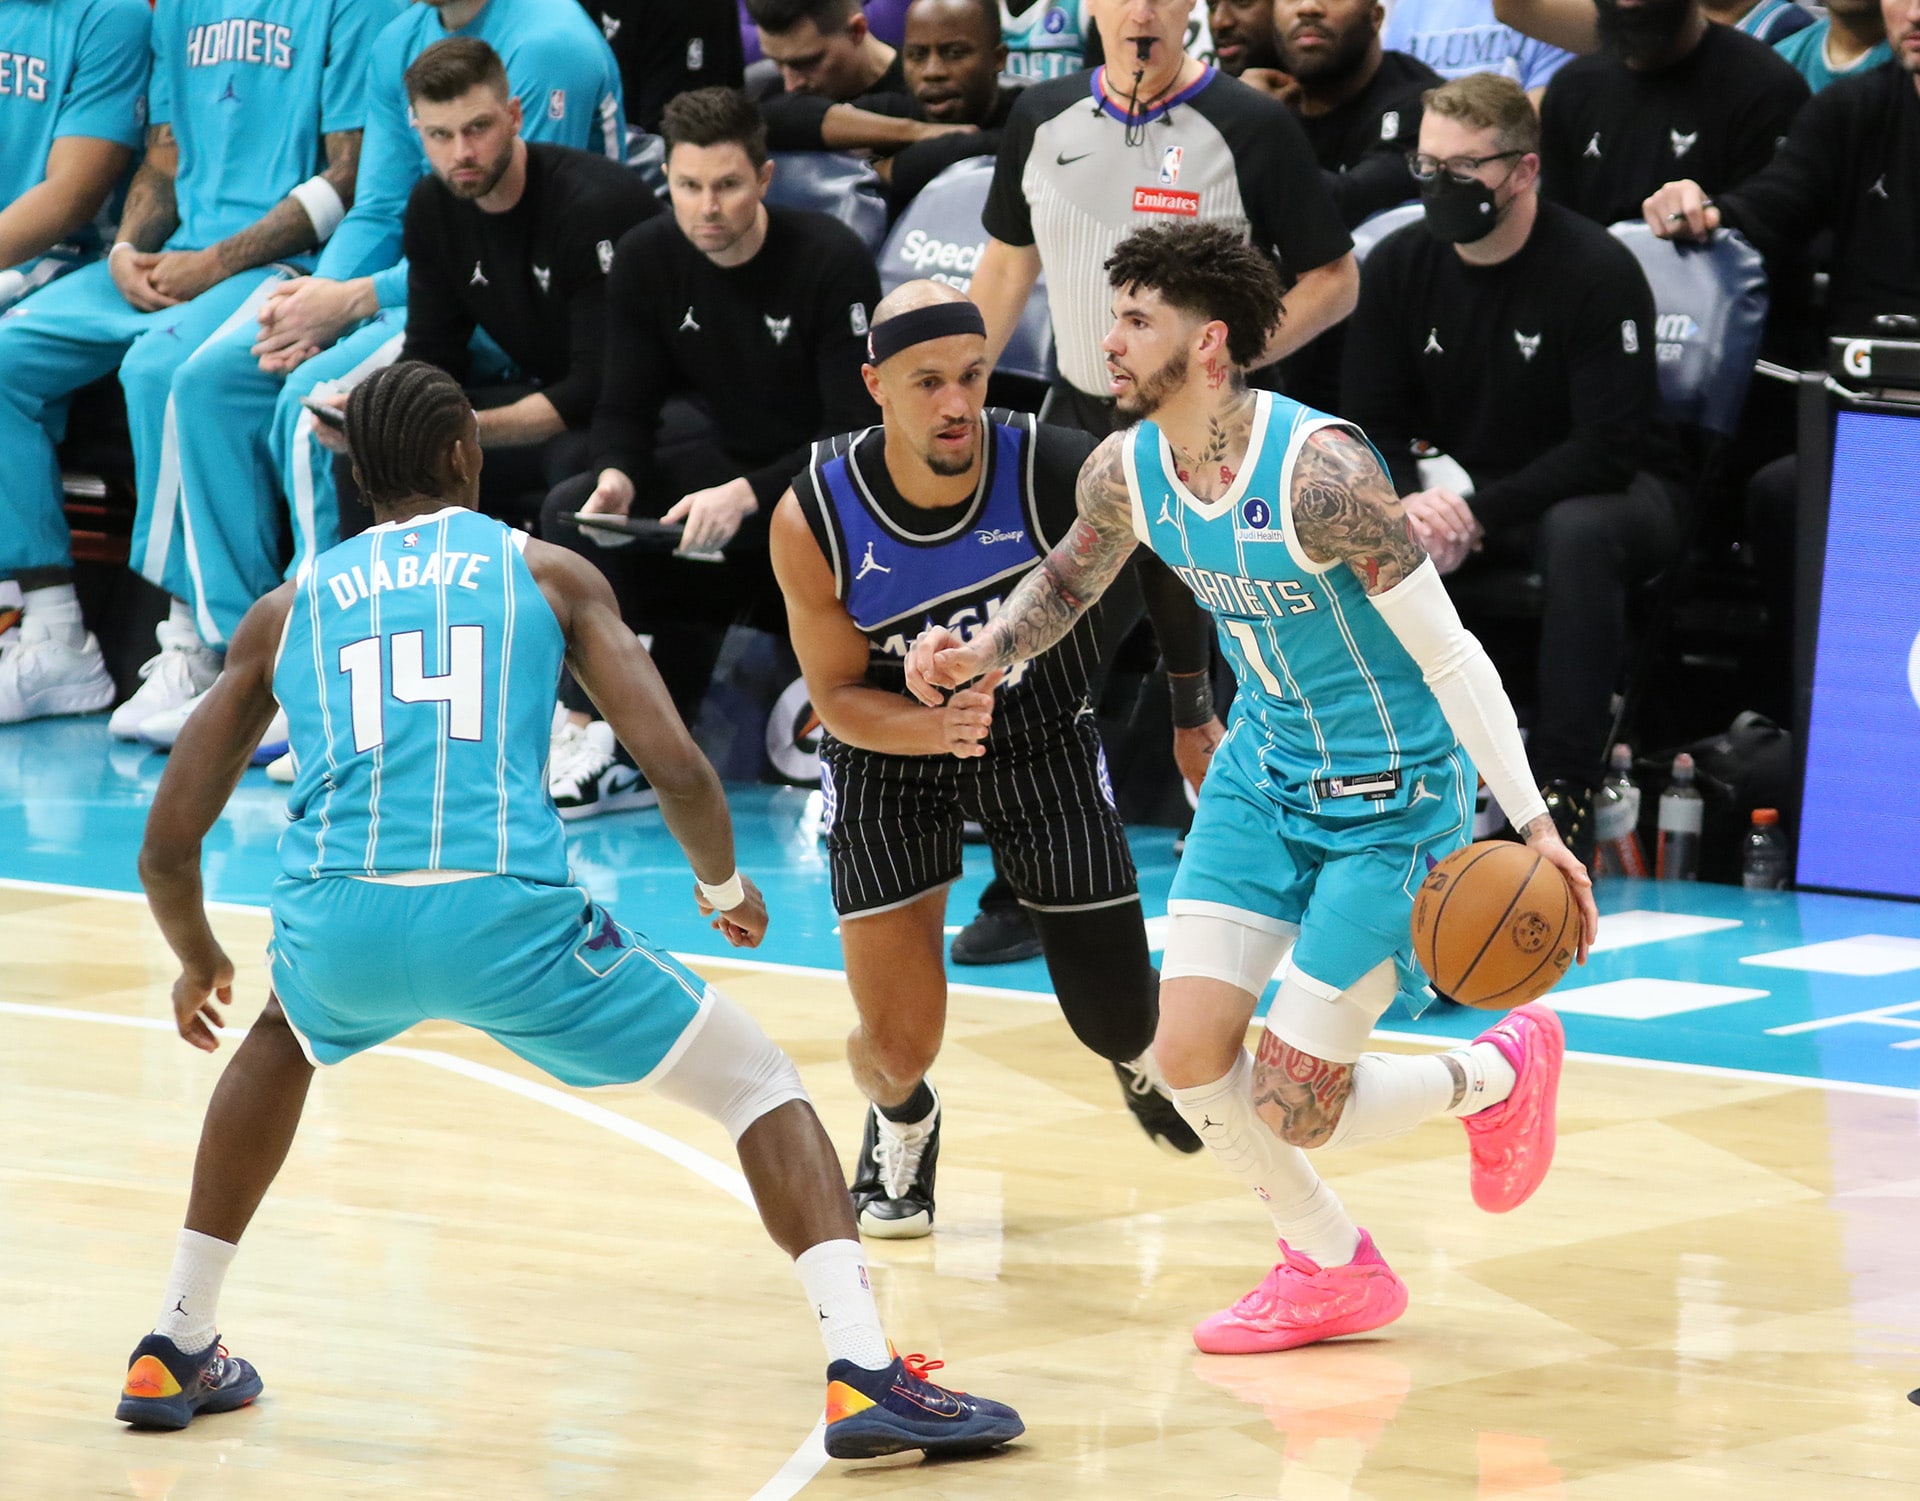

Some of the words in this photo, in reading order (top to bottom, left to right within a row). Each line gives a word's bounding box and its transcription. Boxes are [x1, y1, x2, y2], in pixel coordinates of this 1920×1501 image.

[187, 18, 293, 69] HORNETS
[1135, 191, 1197, 211] Emirates
[974, 529, 1024, 545] Disney
[1239, 531, 1256, 540] Judi
[1257, 531, 1283, 541] Health
[328, 552, 490, 611] DIABATE
[1171, 565, 1318, 617] ORNETS
[1225, 619, 1284, 699] 1
[339, 625, 484, 755] 14
